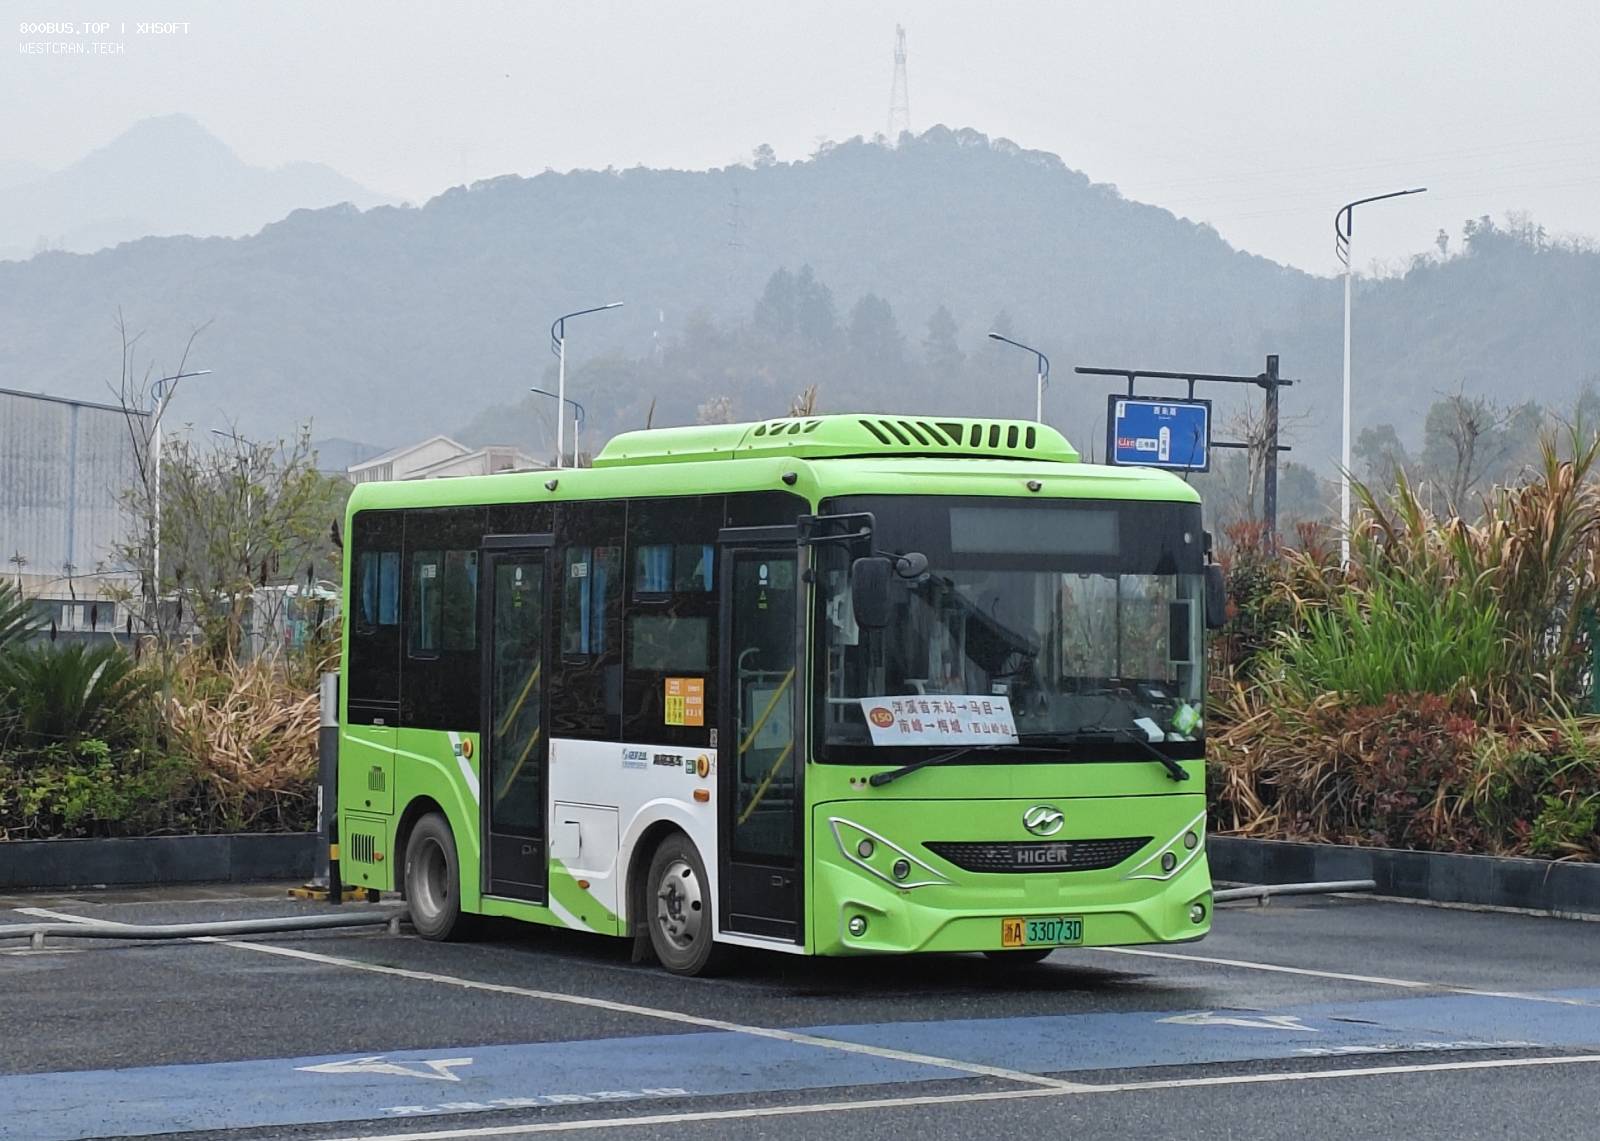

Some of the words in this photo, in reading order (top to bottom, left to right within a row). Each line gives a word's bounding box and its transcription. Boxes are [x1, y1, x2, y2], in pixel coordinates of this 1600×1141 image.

[871, 711, 892, 724] 150
[1017, 849, 1068, 863] HIGER
[1029, 921, 1081, 941] 33073D
